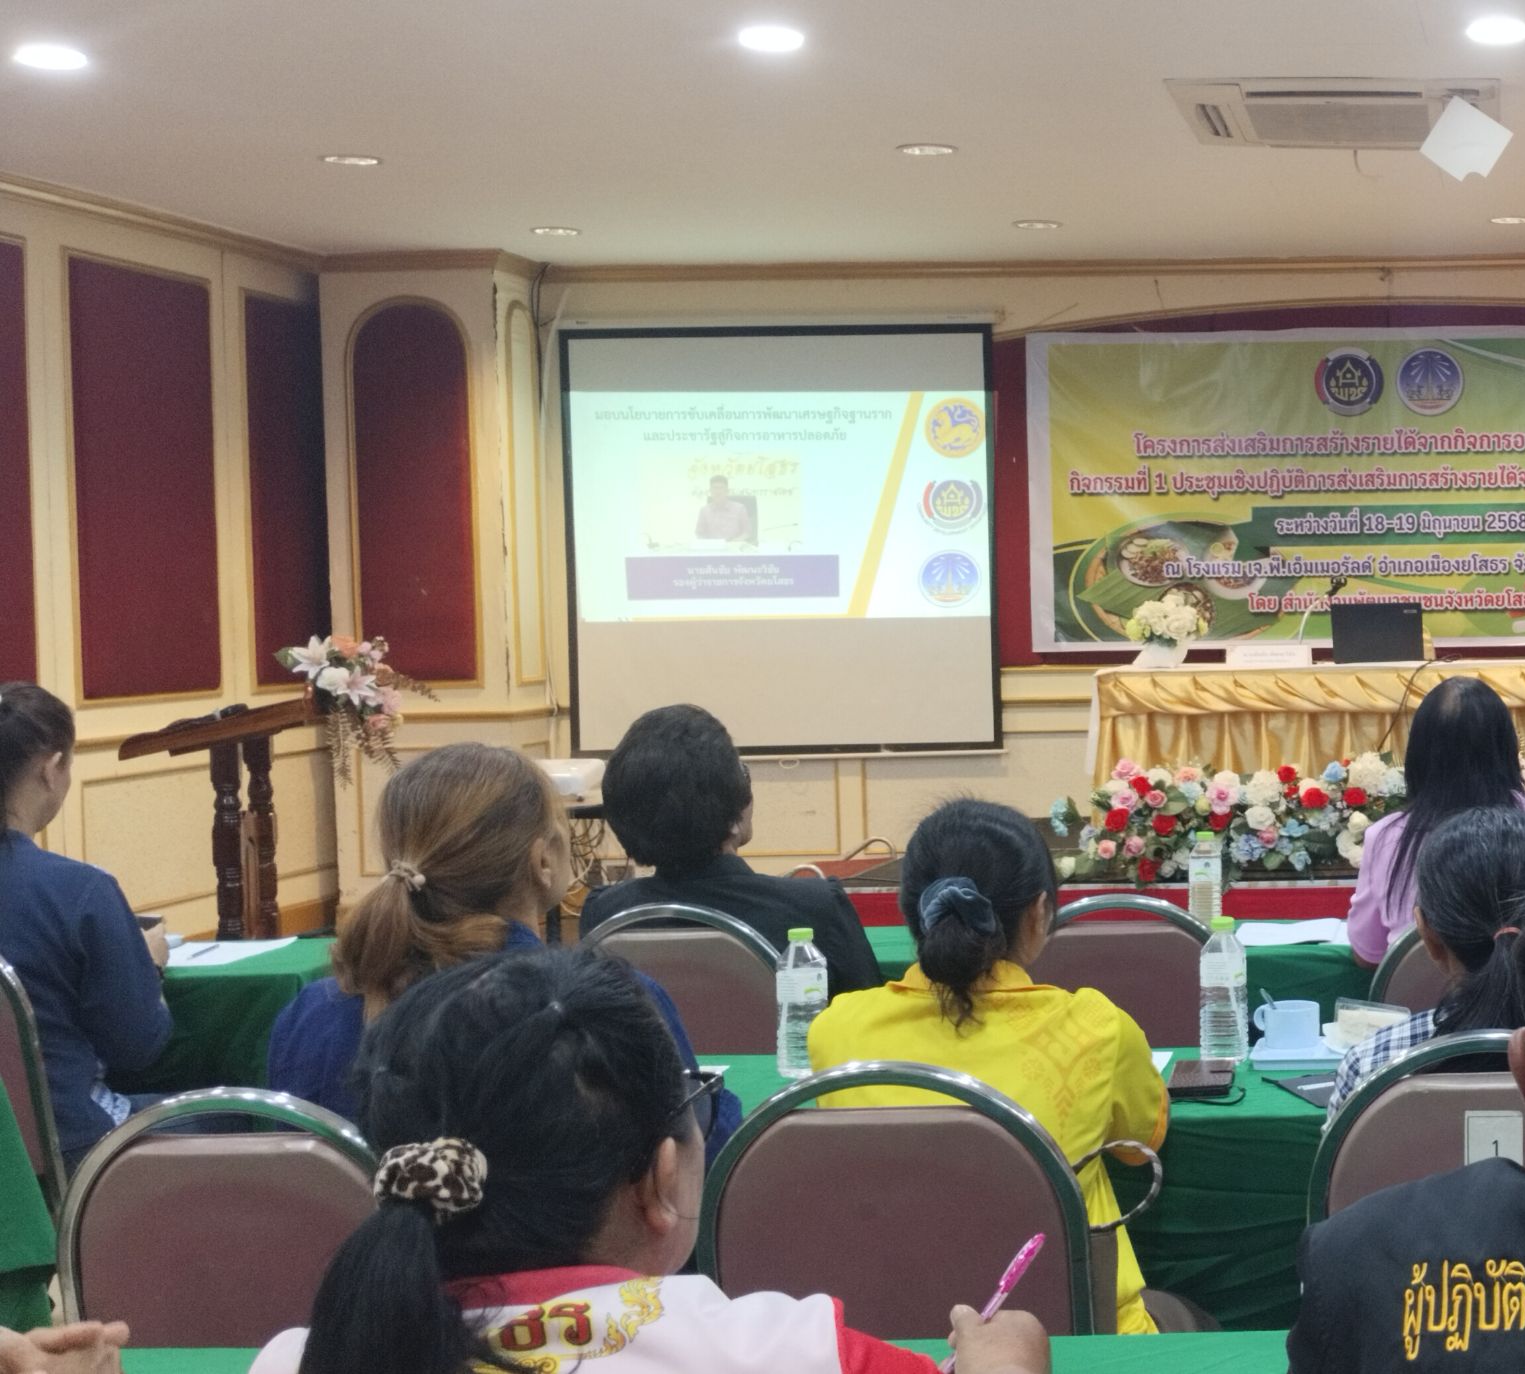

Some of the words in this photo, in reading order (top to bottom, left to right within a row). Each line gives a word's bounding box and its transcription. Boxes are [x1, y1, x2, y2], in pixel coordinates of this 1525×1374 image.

[1069, 466, 1149, 493] กิจกรรมที่
[1154, 472, 1167, 493] 1
[1275, 508, 1360, 534] ระหว่างวันที่
[1363, 513, 1419, 534] 18-19
[1421, 511, 1481, 537] มิถุนายน
[1164, 561, 1182, 578] ณ
[1186, 557, 1242, 578] โรงแรม
[1378, 553, 1510, 575] อำเภอเมืองยโสธร
[1247, 591, 1279, 613] โดย
[1491, 1139, 1500, 1157] 1
[498, 1301, 592, 1352] ธร
